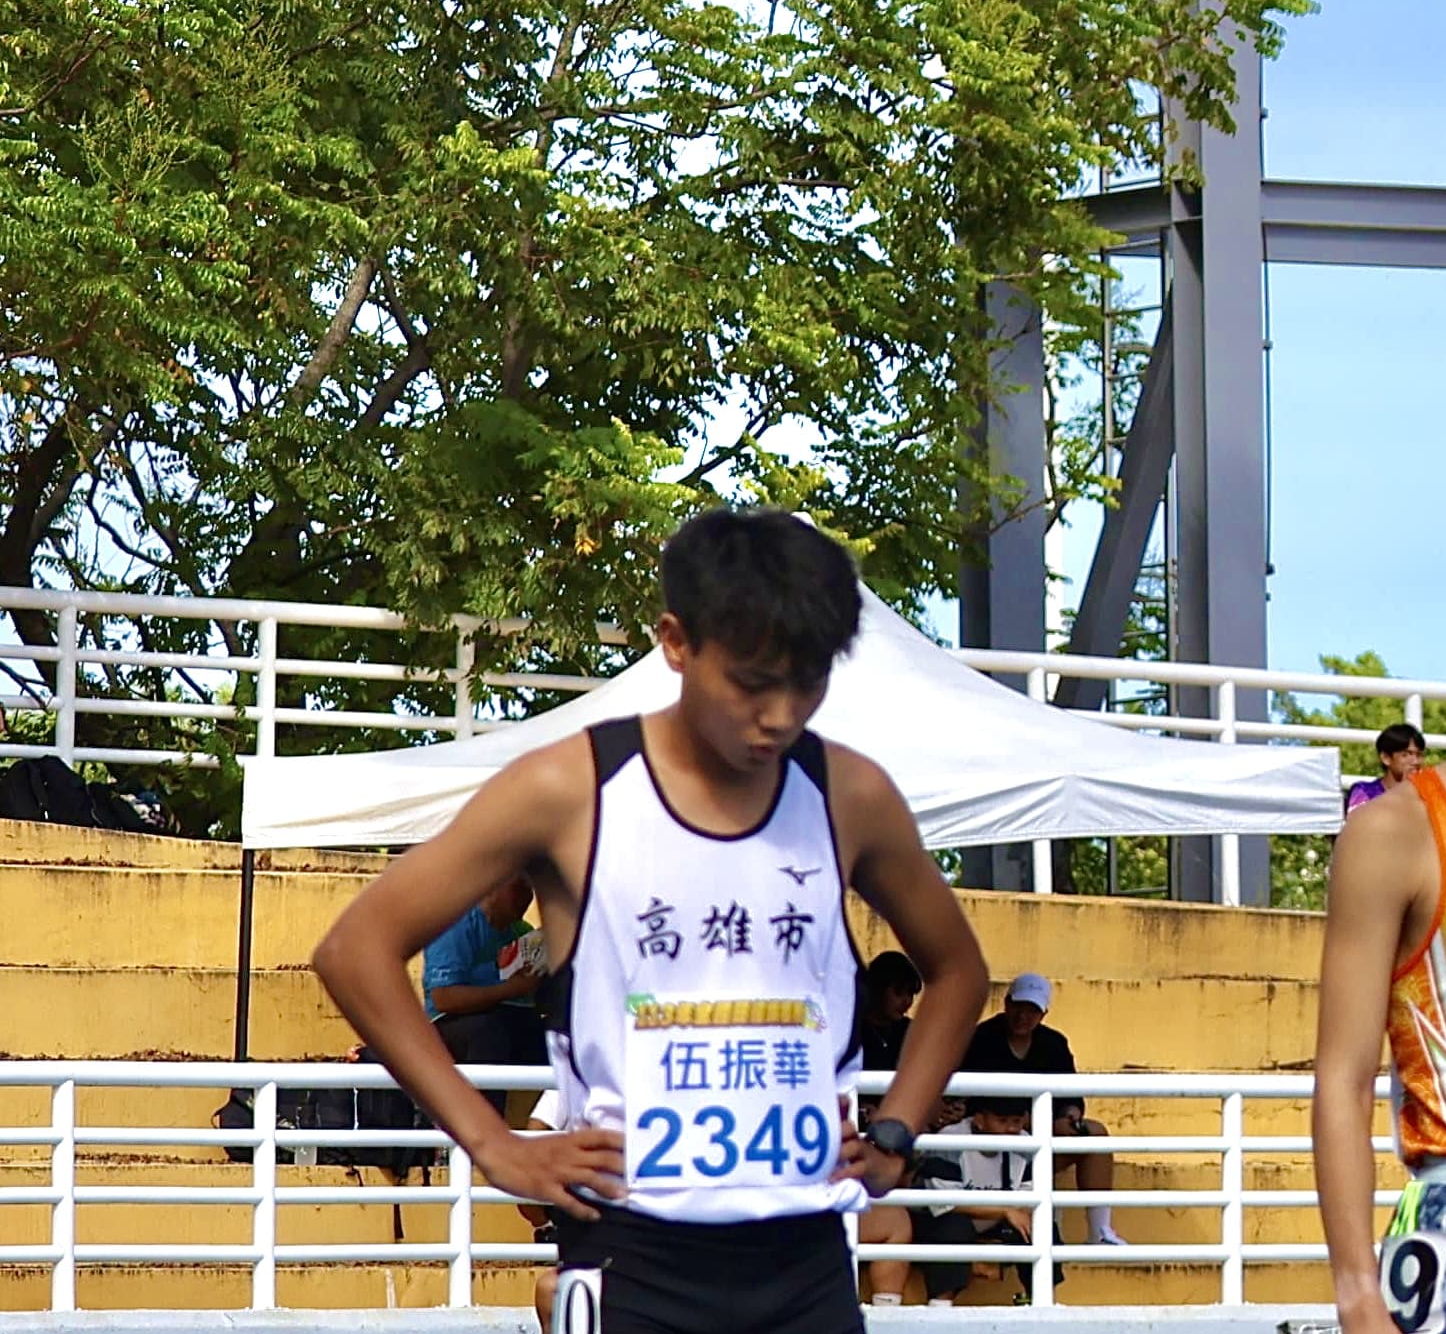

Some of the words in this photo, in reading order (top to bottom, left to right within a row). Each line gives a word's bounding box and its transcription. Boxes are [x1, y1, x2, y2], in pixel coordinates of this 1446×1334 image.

[637, 897, 814, 964] 高雄市
[661, 1039, 810, 1092] 伍振華
[636, 1104, 829, 1178] 2349
[1389, 1238, 1439, 1334] 9
